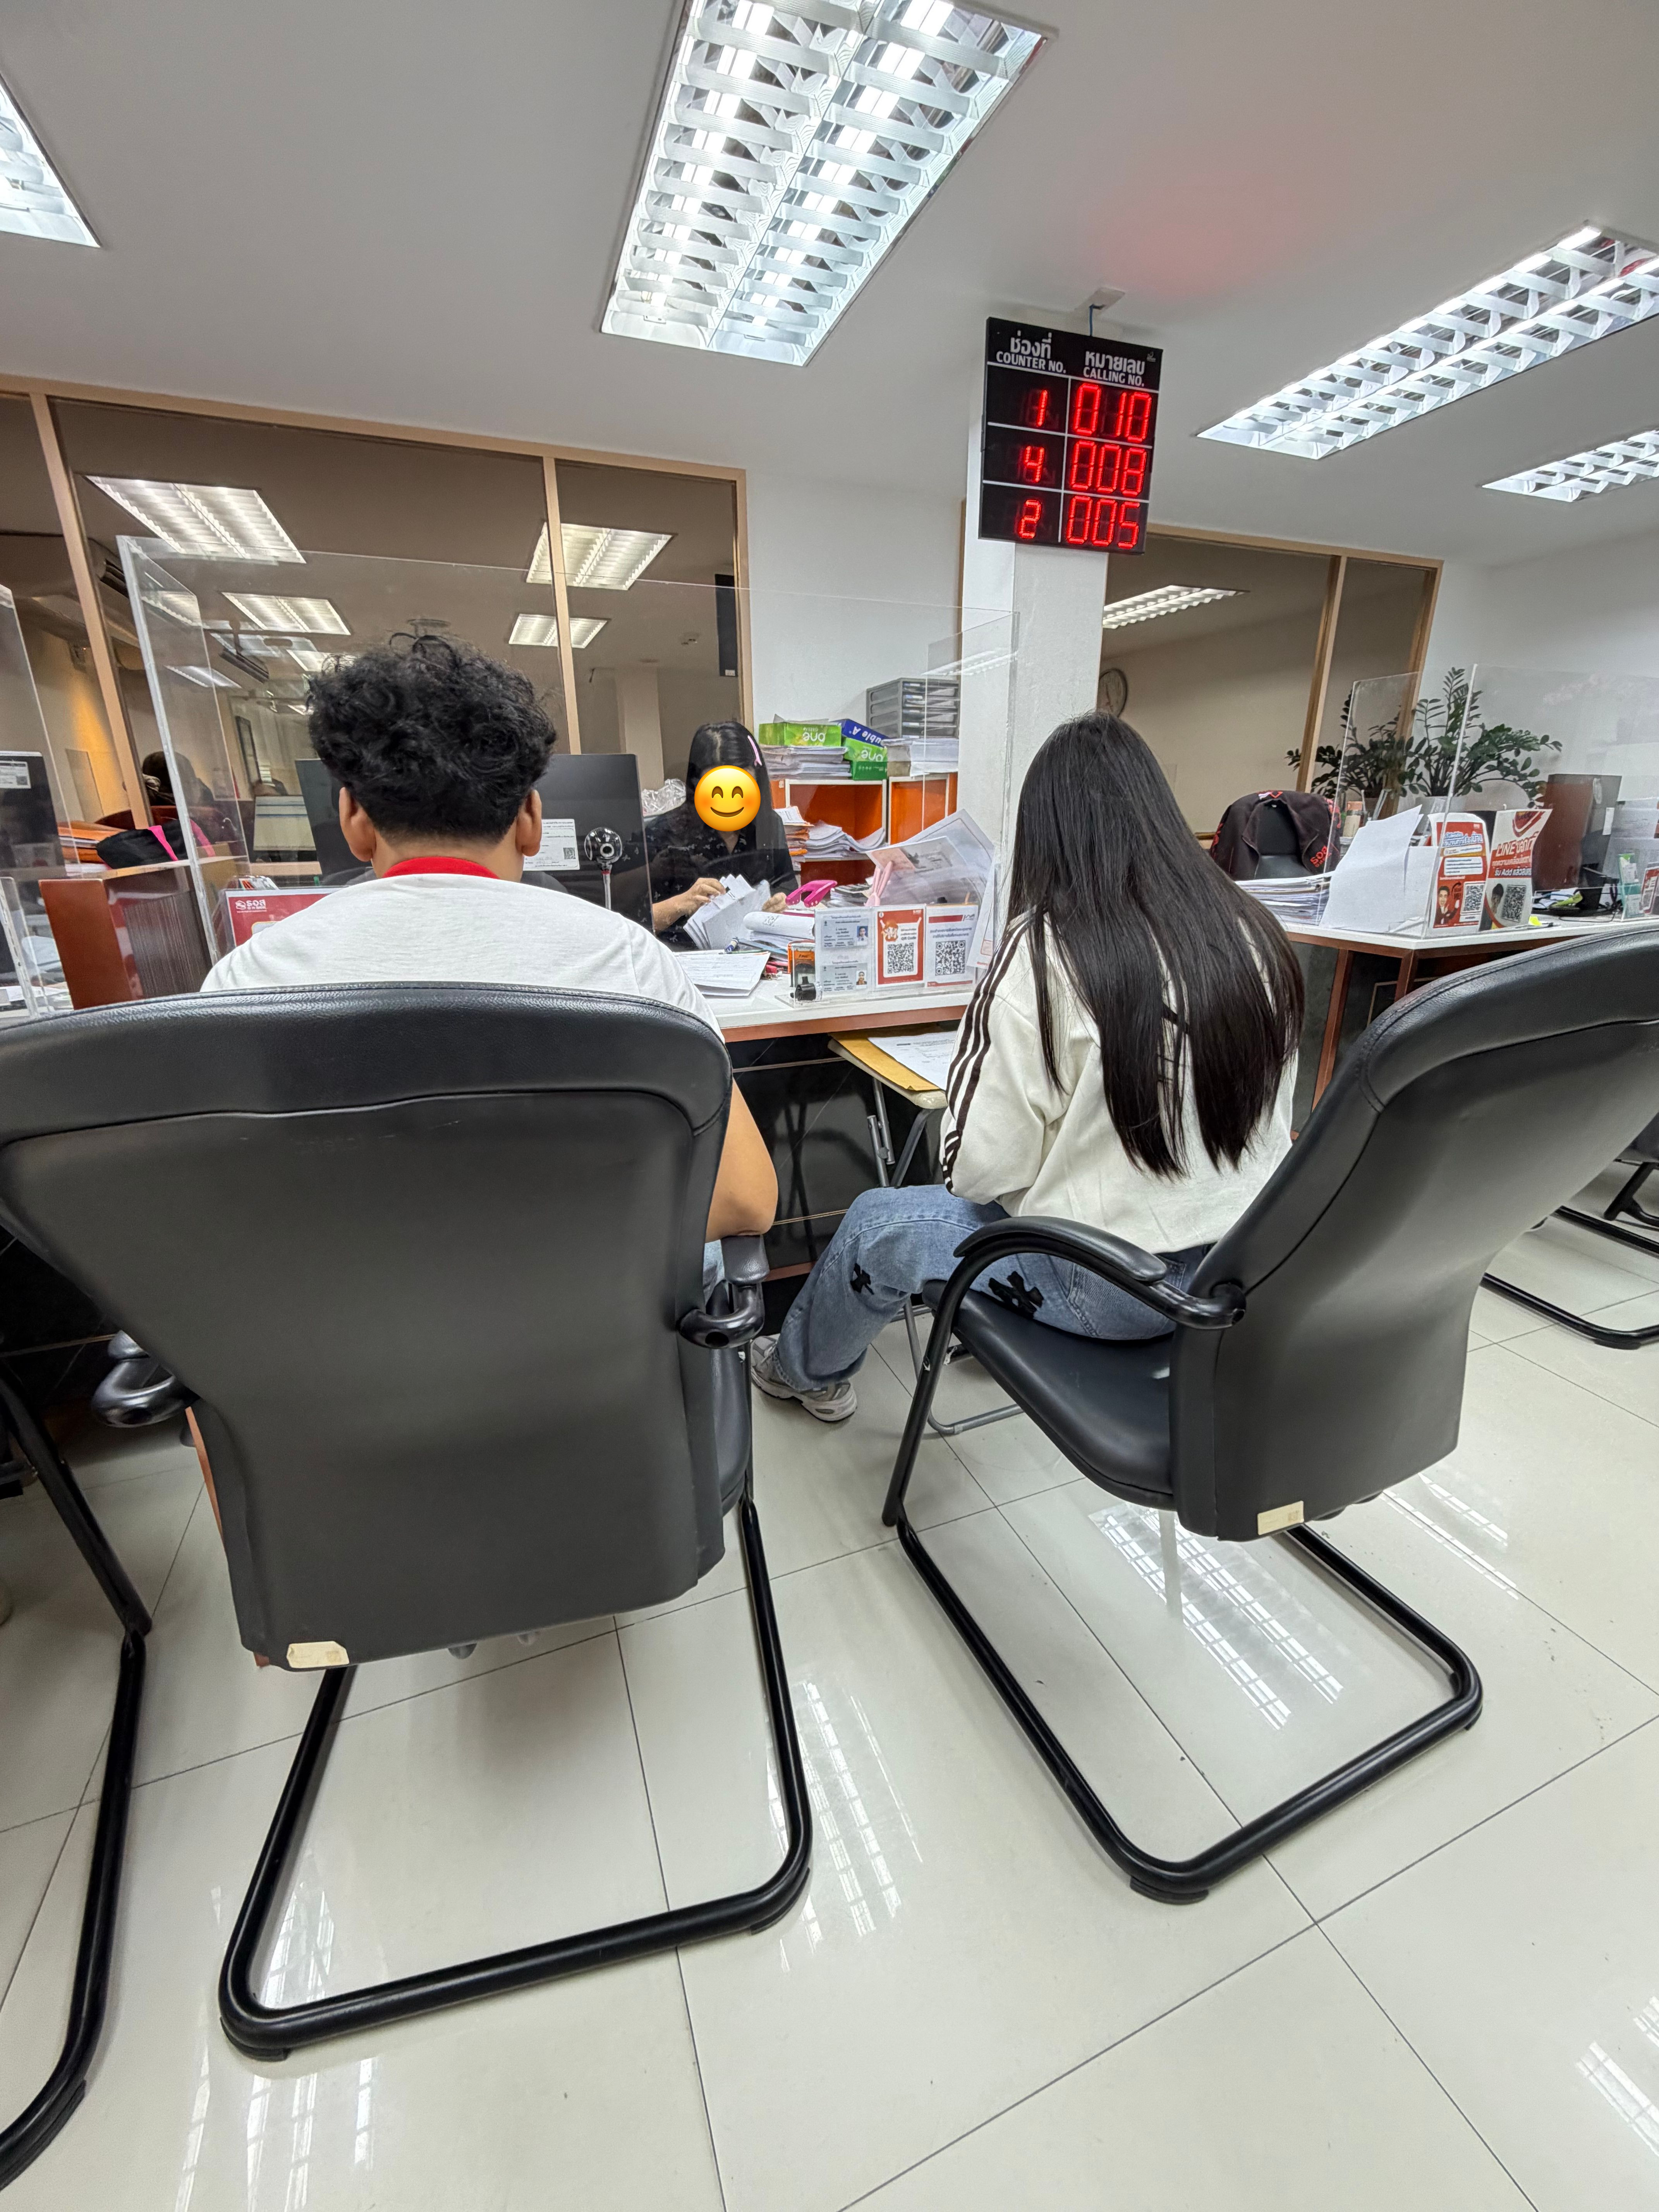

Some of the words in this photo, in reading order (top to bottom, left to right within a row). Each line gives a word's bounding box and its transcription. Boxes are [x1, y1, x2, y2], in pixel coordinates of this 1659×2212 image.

[1010, 330, 1052, 359] ช่องที่
[996, 351, 1046, 370] COUNTER
[1048, 360, 1066, 373] NO.
[1085, 351, 1145, 375] หมายเลข
[1084, 366, 1125, 383] CALLING
[1128, 374, 1145, 386] NO.
[1037, 390, 1048, 427] 1
[1073, 383, 1152, 442] 010
[1024, 445, 1045, 483] 4
[1070, 440, 1147, 497] 008
[1018, 498, 1042, 539] 2
[1066, 495, 1140, 549] 005
[803, 732, 826, 742] one
[862, 730, 882, 744] uble
[861, 749, 884, 762] one
[1496, 840, 1516, 857] LINE
